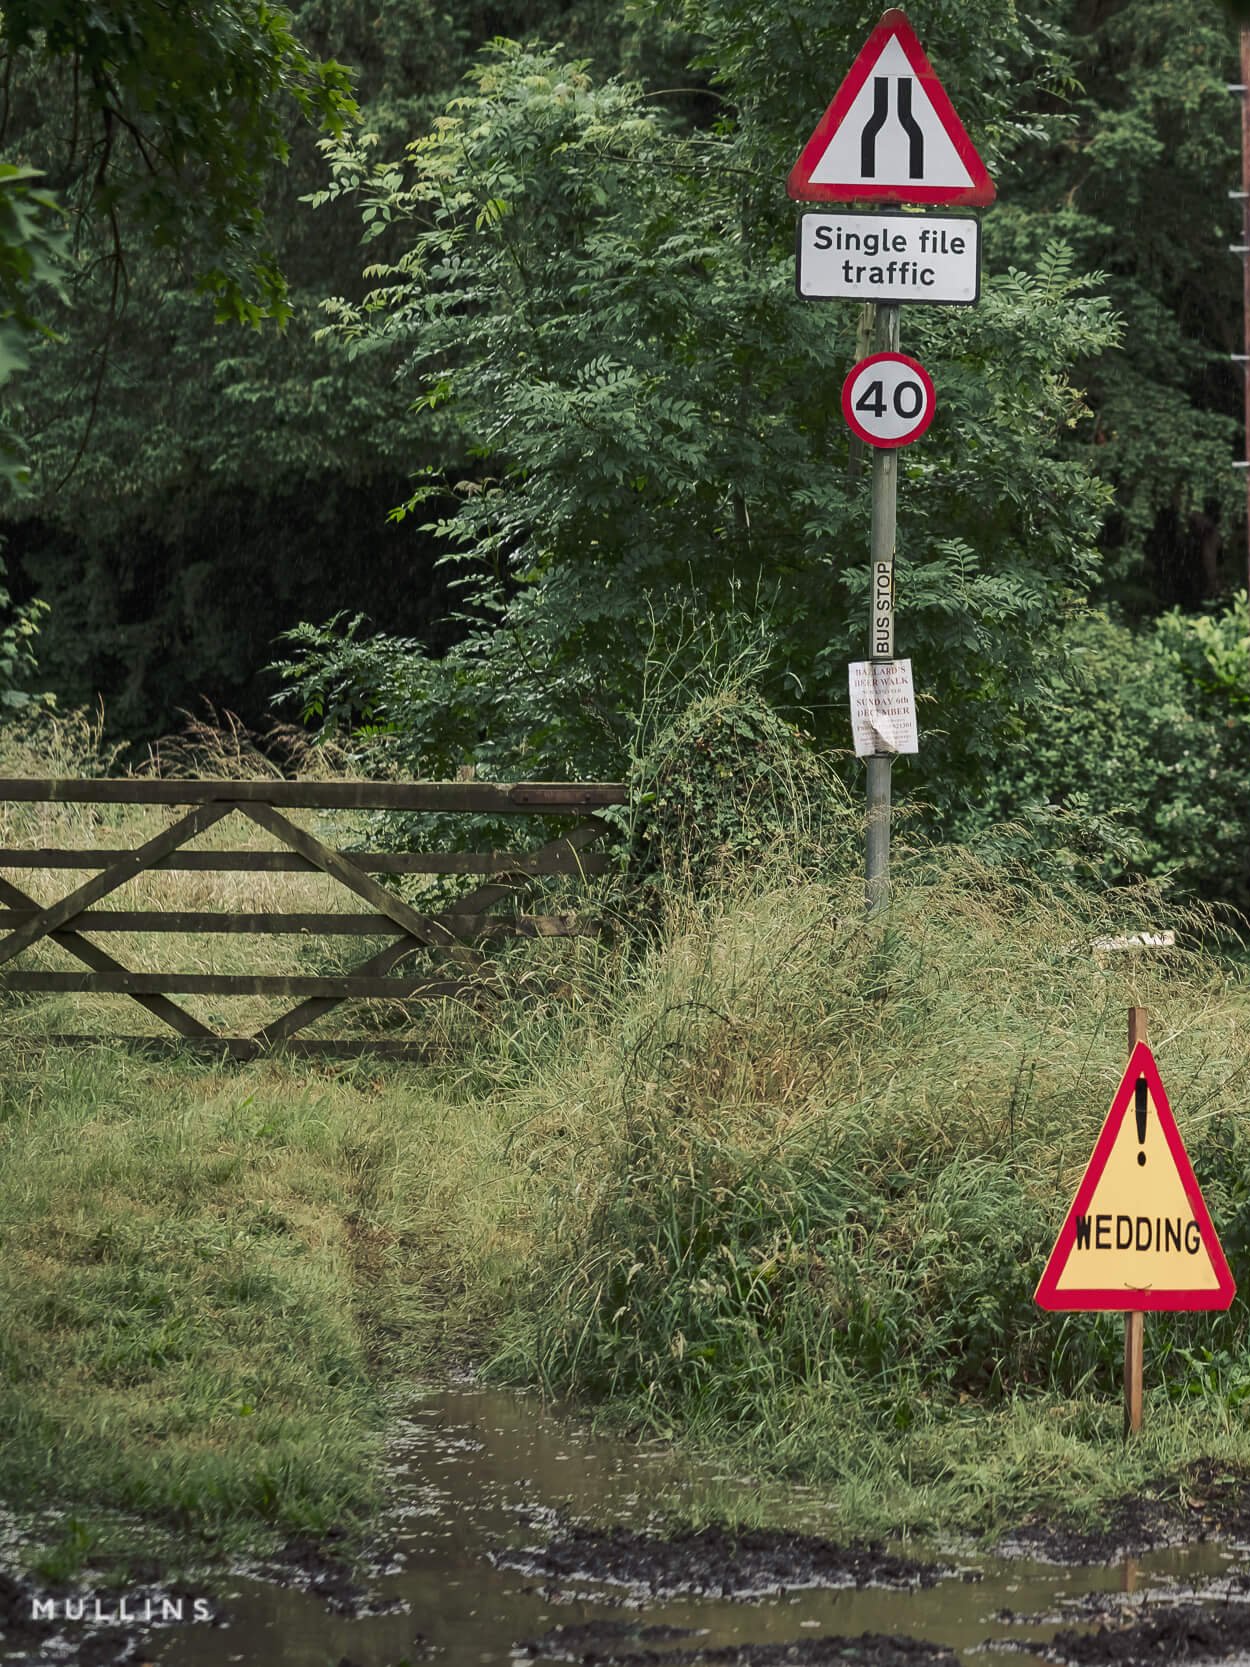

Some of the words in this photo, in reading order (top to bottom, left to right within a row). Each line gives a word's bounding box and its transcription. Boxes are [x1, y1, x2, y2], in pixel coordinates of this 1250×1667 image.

[813, 225, 907, 256] Single
[919, 230, 966, 255] file
[842, 260, 936, 286] traffic
[855, 380, 924, 419] 40
[877, 563, 891, 611] STOP
[877, 617, 890, 654] BUS
[880, 678, 909, 686] WALK
[856, 698, 893, 707] SUNDAY
[1076, 1214, 1201, 1255] WEDDING
